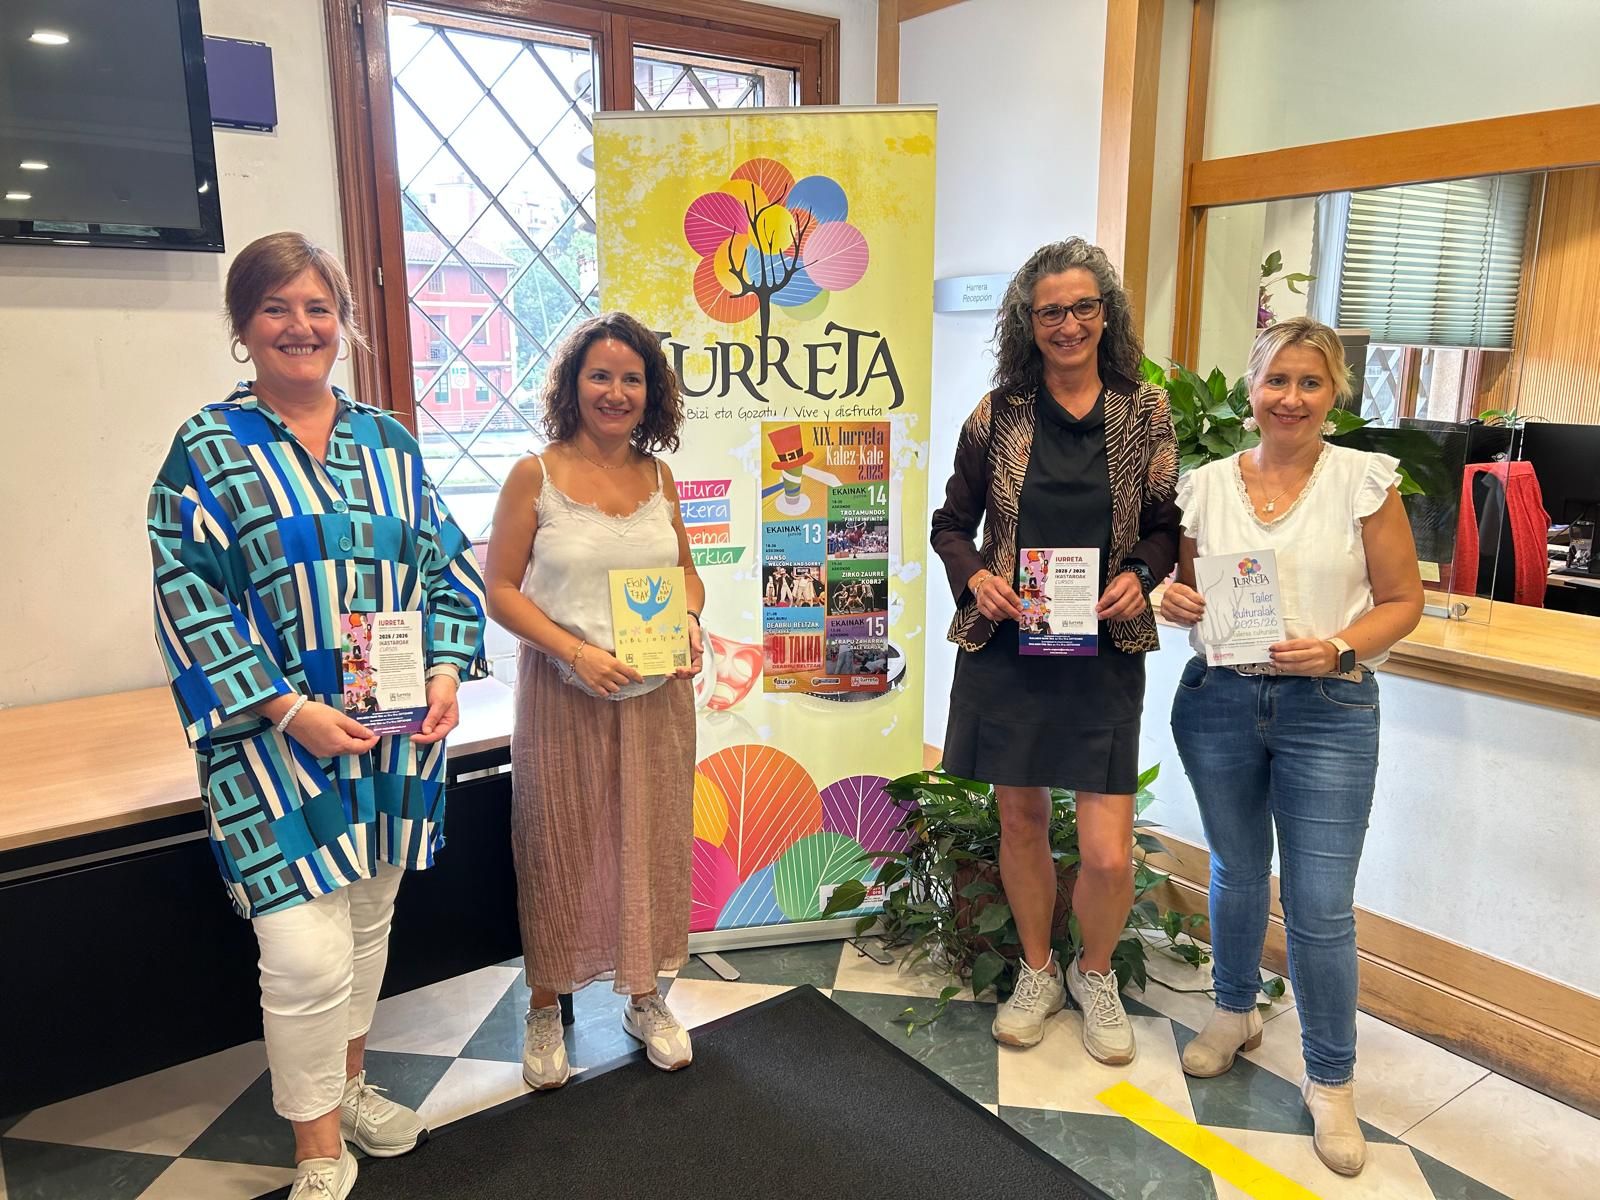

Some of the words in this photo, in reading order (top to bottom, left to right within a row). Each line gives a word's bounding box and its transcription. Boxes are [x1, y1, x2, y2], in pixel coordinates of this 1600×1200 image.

[962, 294, 992, 303] Recepción
[654, 321, 904, 410] URRETA
[686, 407, 708, 420] Bizi
[714, 406, 732, 419] eta
[784, 406, 788, 417] /
[794, 405, 818, 418] Vive
[824, 409, 830, 423] y
[835, 404, 882, 418] disfruta
[838, 426, 884, 446] Iurreta
[832, 488, 866, 496] EKAINAK
[868, 485, 886, 506] 14
[766, 526, 801, 534] EKAINAK
[802, 523, 822, 544] 13
[1232, 574, 1270, 588] IURRETA
[831, 618, 864, 626] EKAINAK
[866, 616, 884, 637] 15
[772, 636, 786, 664] SU
[788, 635, 821, 664] TALKA
